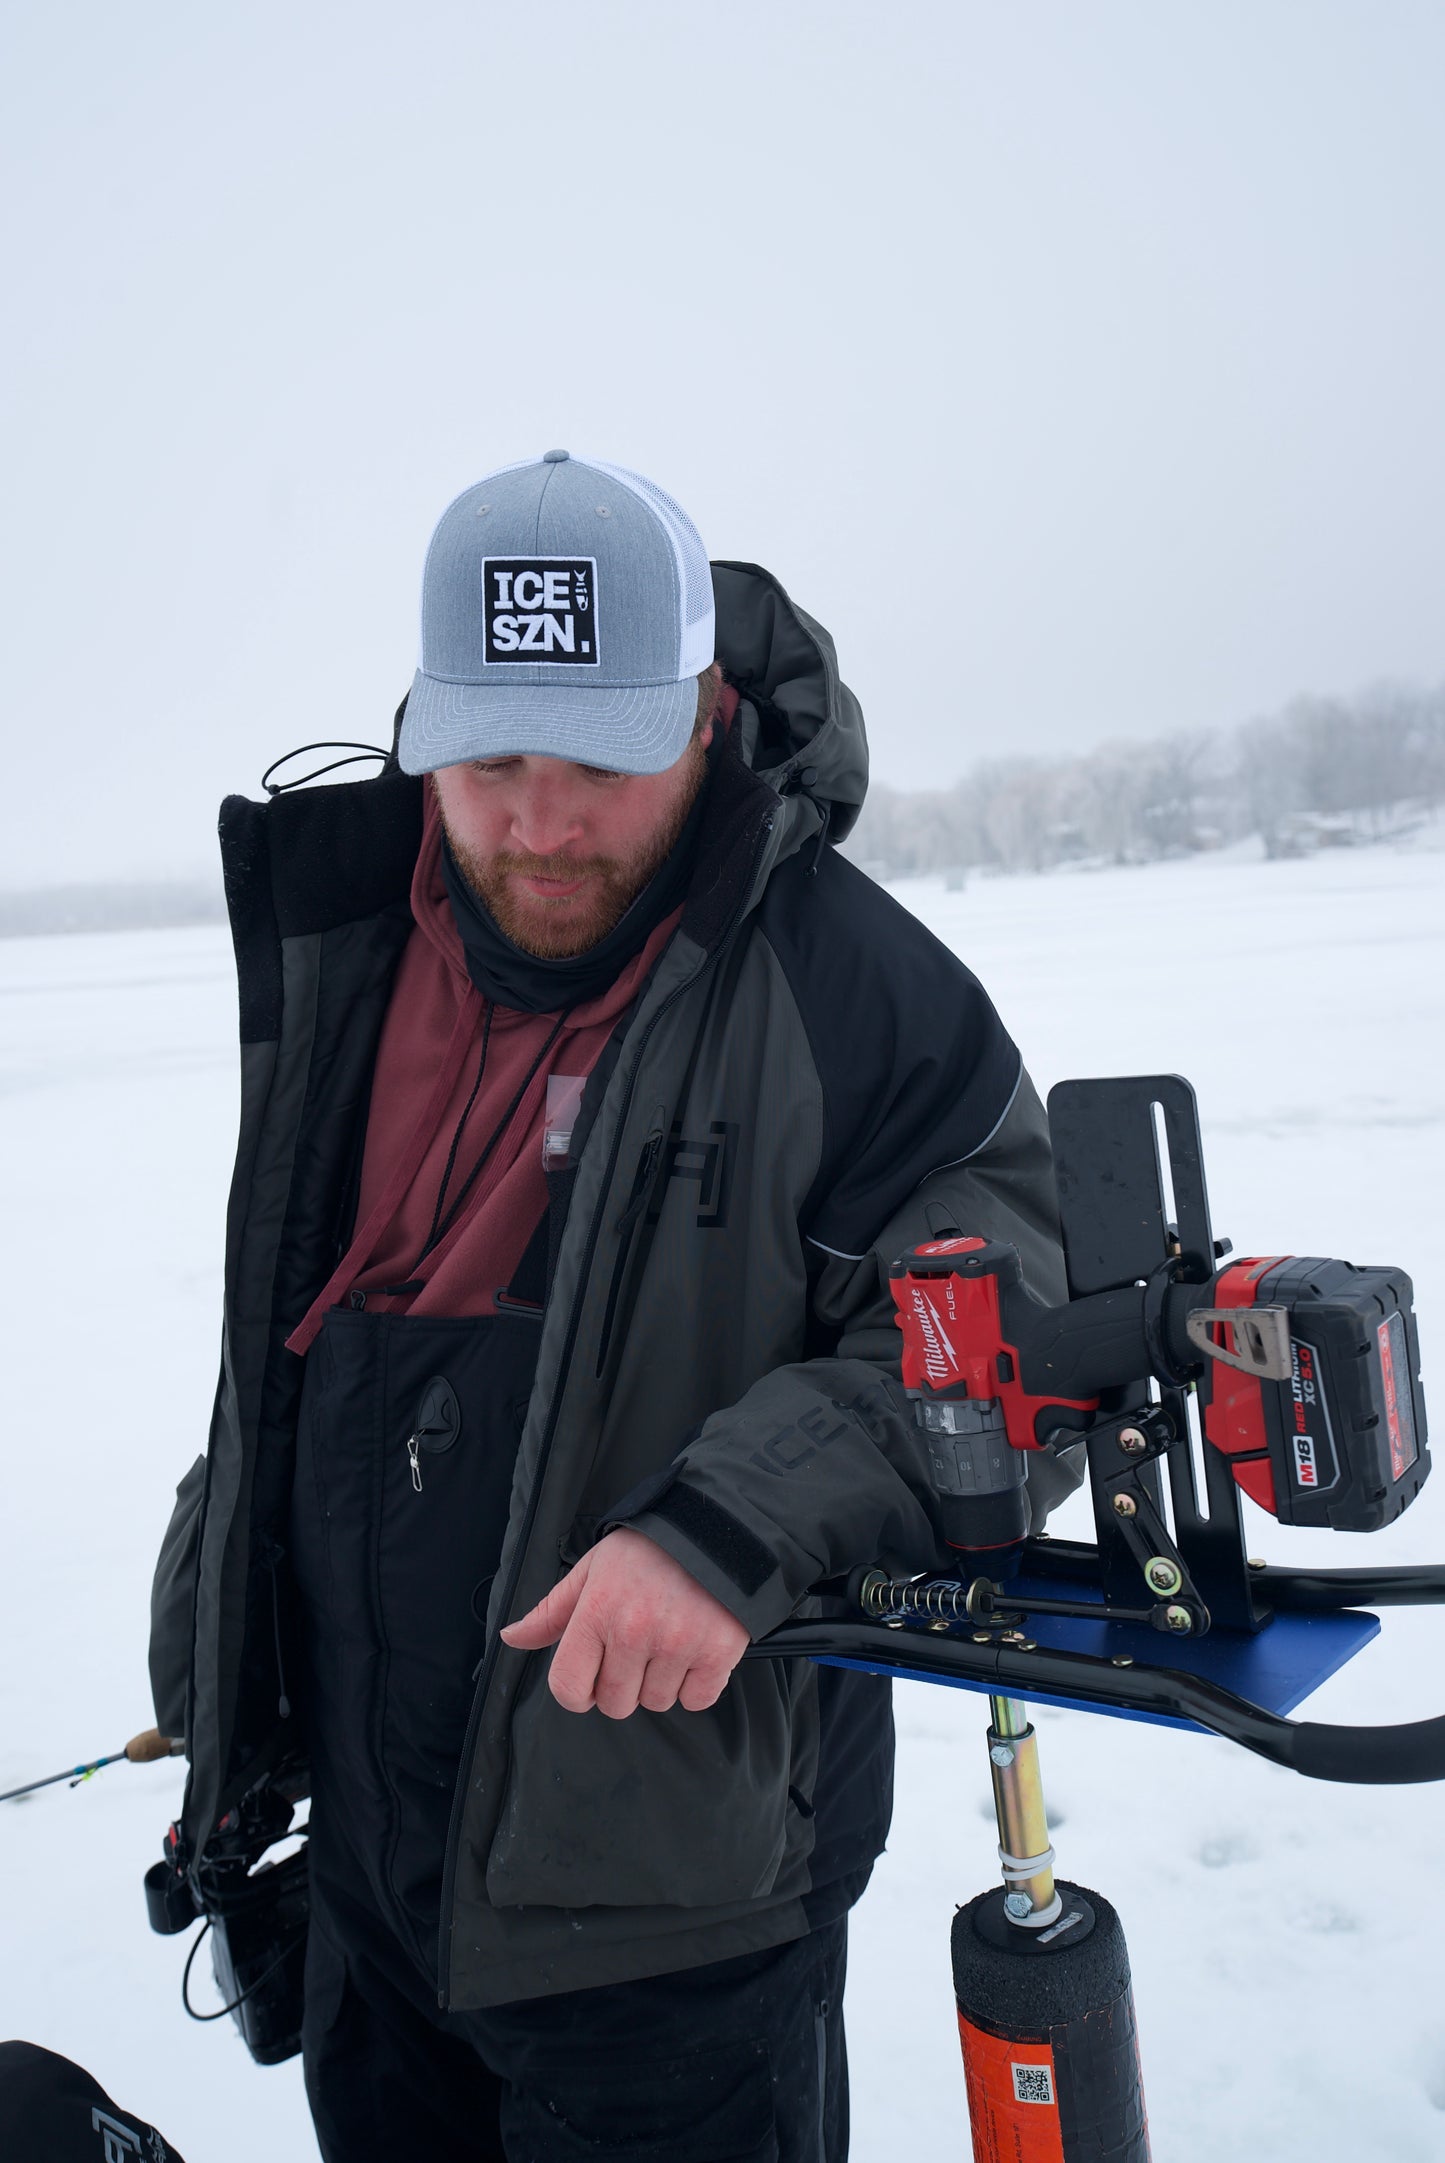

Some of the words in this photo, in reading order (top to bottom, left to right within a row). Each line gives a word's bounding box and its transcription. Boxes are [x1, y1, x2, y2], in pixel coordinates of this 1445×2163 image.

[493, 571, 571, 610] ICE
[492, 614, 590, 652] SZN.
[945, 1281, 957, 1320] FUEL
[911, 1288, 949, 1381] Milwaukee
[749, 1406, 849, 1477] ICE
[1297, 1439, 1315, 1483] M18
